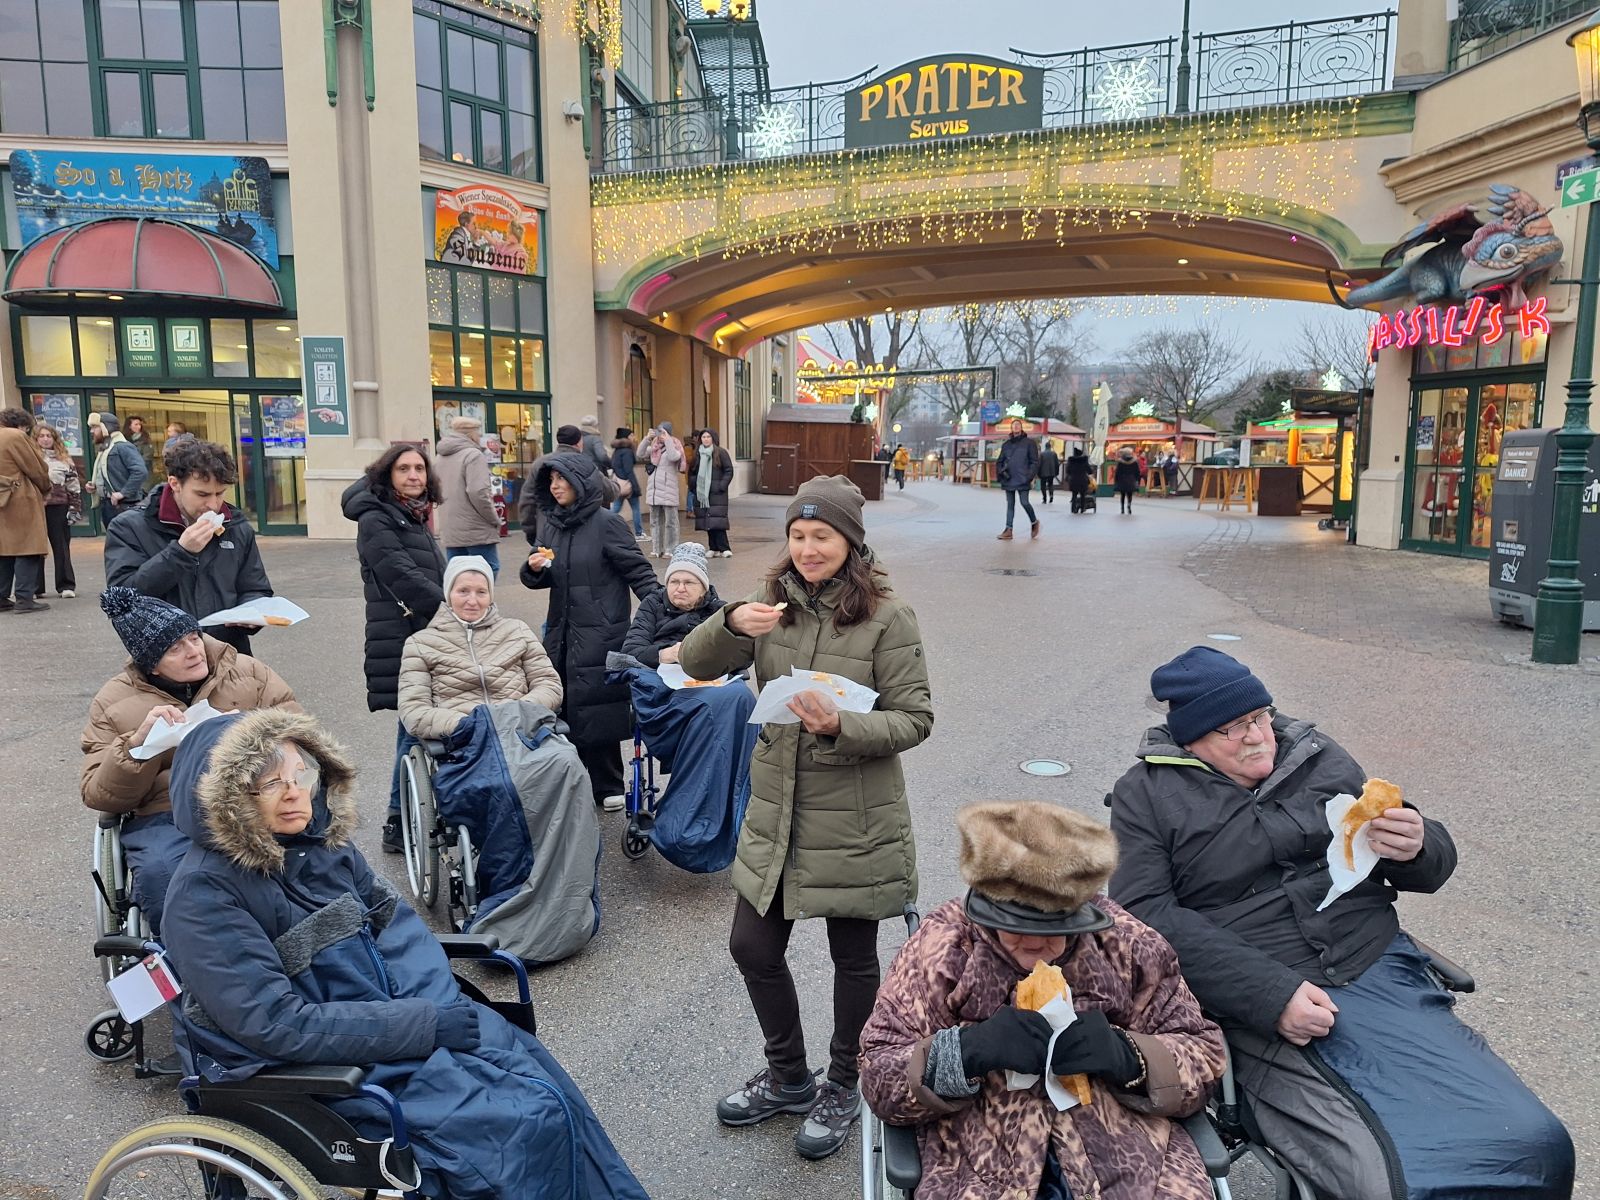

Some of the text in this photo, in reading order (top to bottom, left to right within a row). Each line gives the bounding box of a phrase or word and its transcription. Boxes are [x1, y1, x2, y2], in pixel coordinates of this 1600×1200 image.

[858, 62, 1027, 122] PRATER
[909, 118, 970, 139] Servus
[54, 160, 193, 193] So a Hetz
[458, 192, 480, 205] Wiener
[452, 240, 526, 271] Souvenir
[1504, 467, 1528, 478] DANKE!
